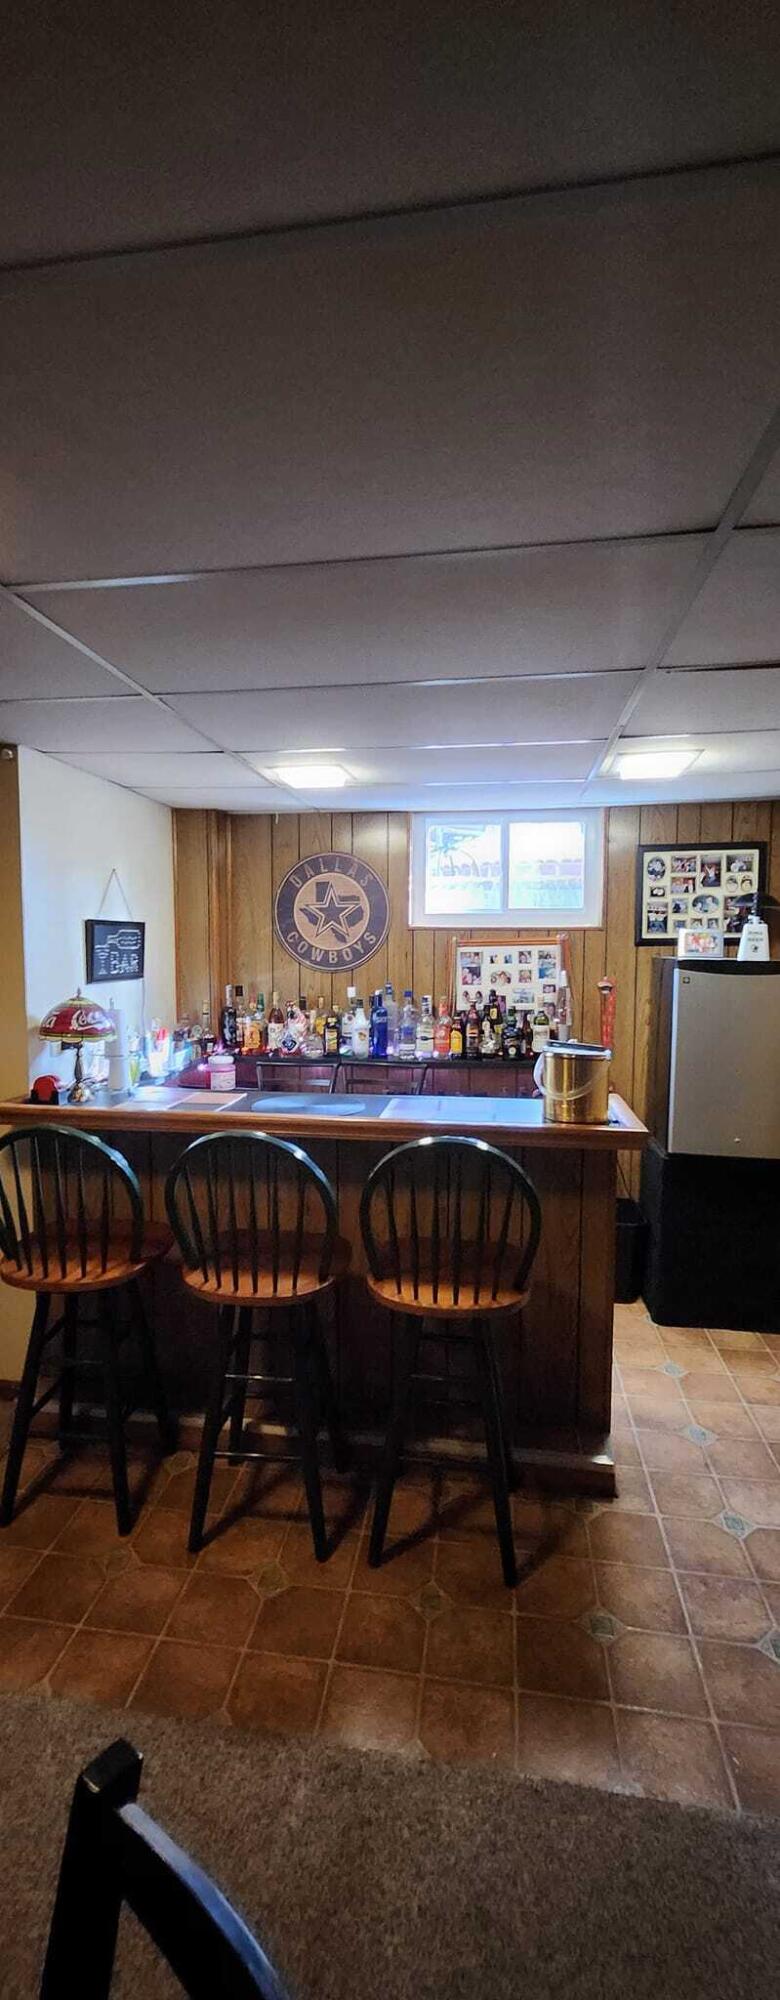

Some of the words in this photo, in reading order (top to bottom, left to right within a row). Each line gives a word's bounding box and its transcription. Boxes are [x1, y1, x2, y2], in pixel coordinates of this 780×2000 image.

[289, 858, 374, 888] DALLAS
[110, 951, 139, 974] BAR
[287, 931, 376, 964] COWBOYS
